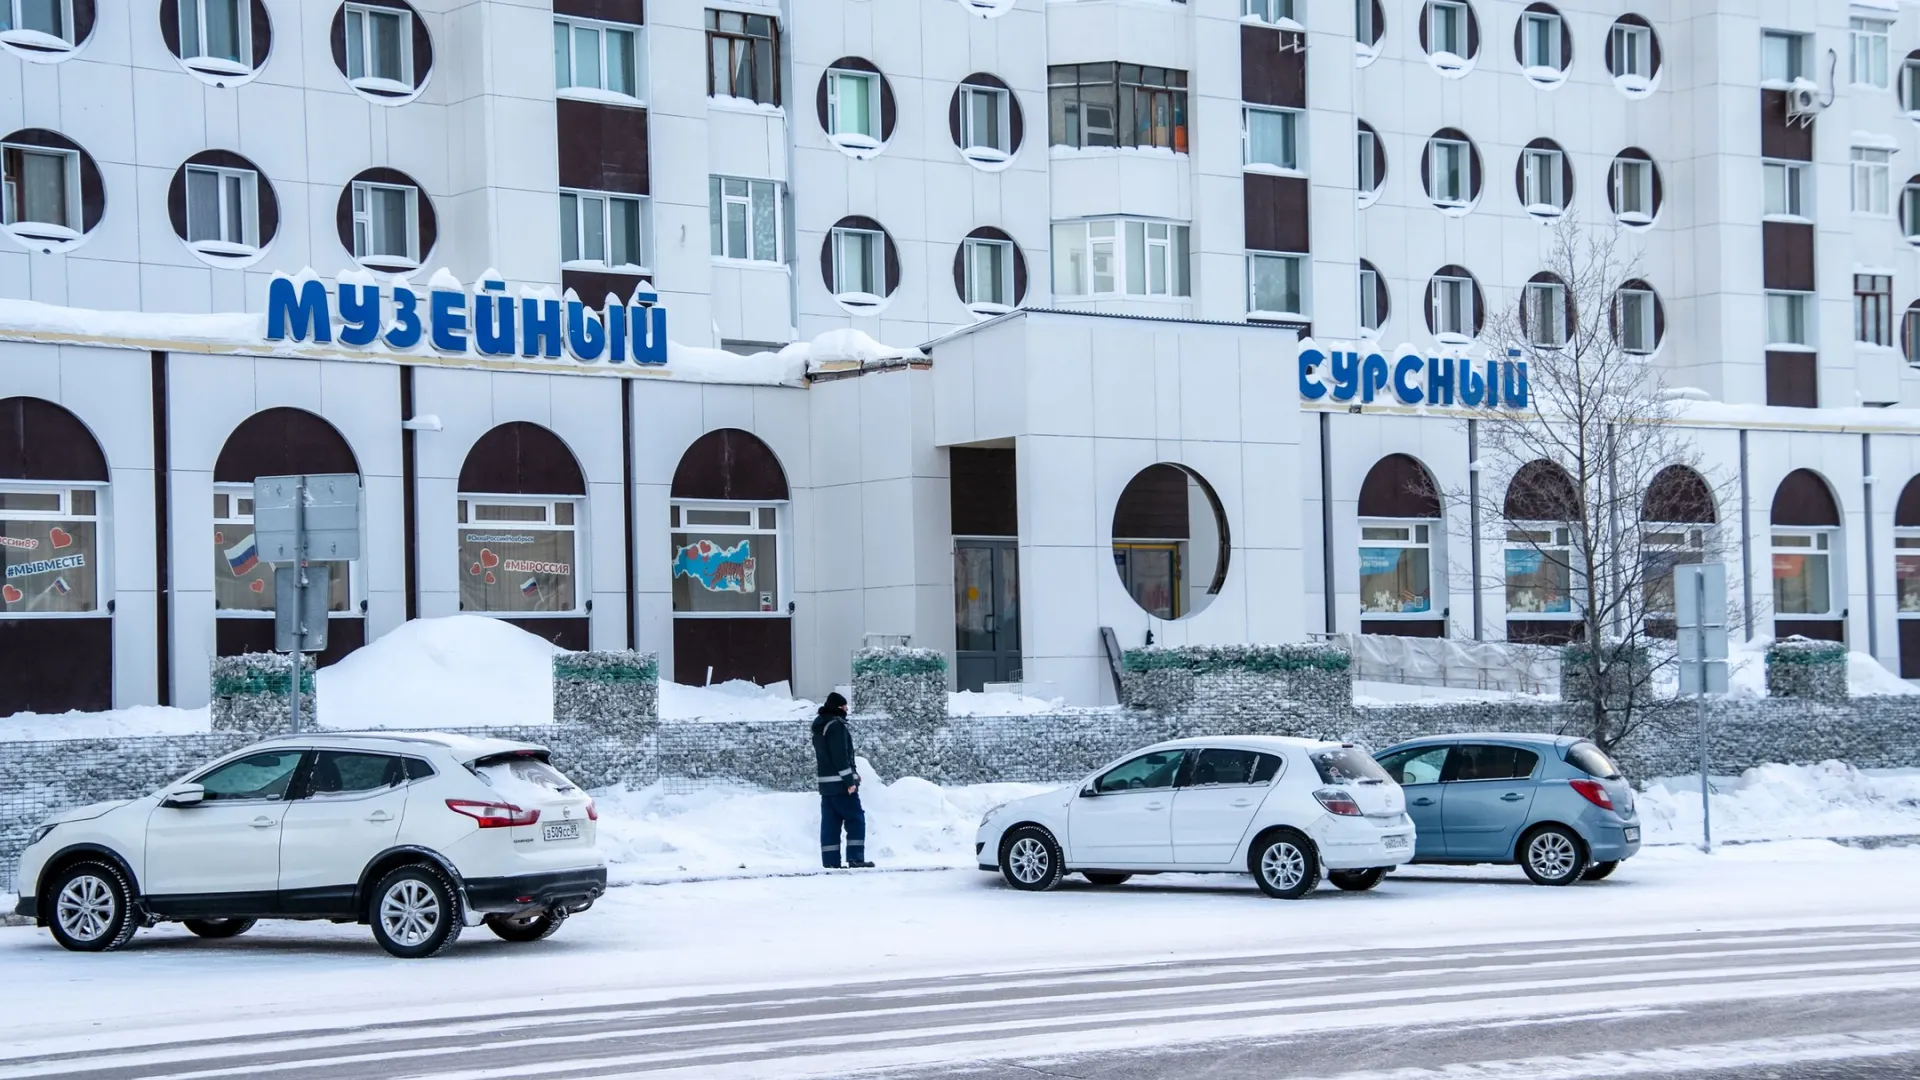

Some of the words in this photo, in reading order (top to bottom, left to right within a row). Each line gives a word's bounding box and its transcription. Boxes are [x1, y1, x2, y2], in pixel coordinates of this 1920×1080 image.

[267, 276, 668, 366] МУЗЕЙНЫЙ
[7, 555, 84, 577] #МЫВМЕСТЕ
[505, 560, 569, 574] #МЫРОССИЯ
